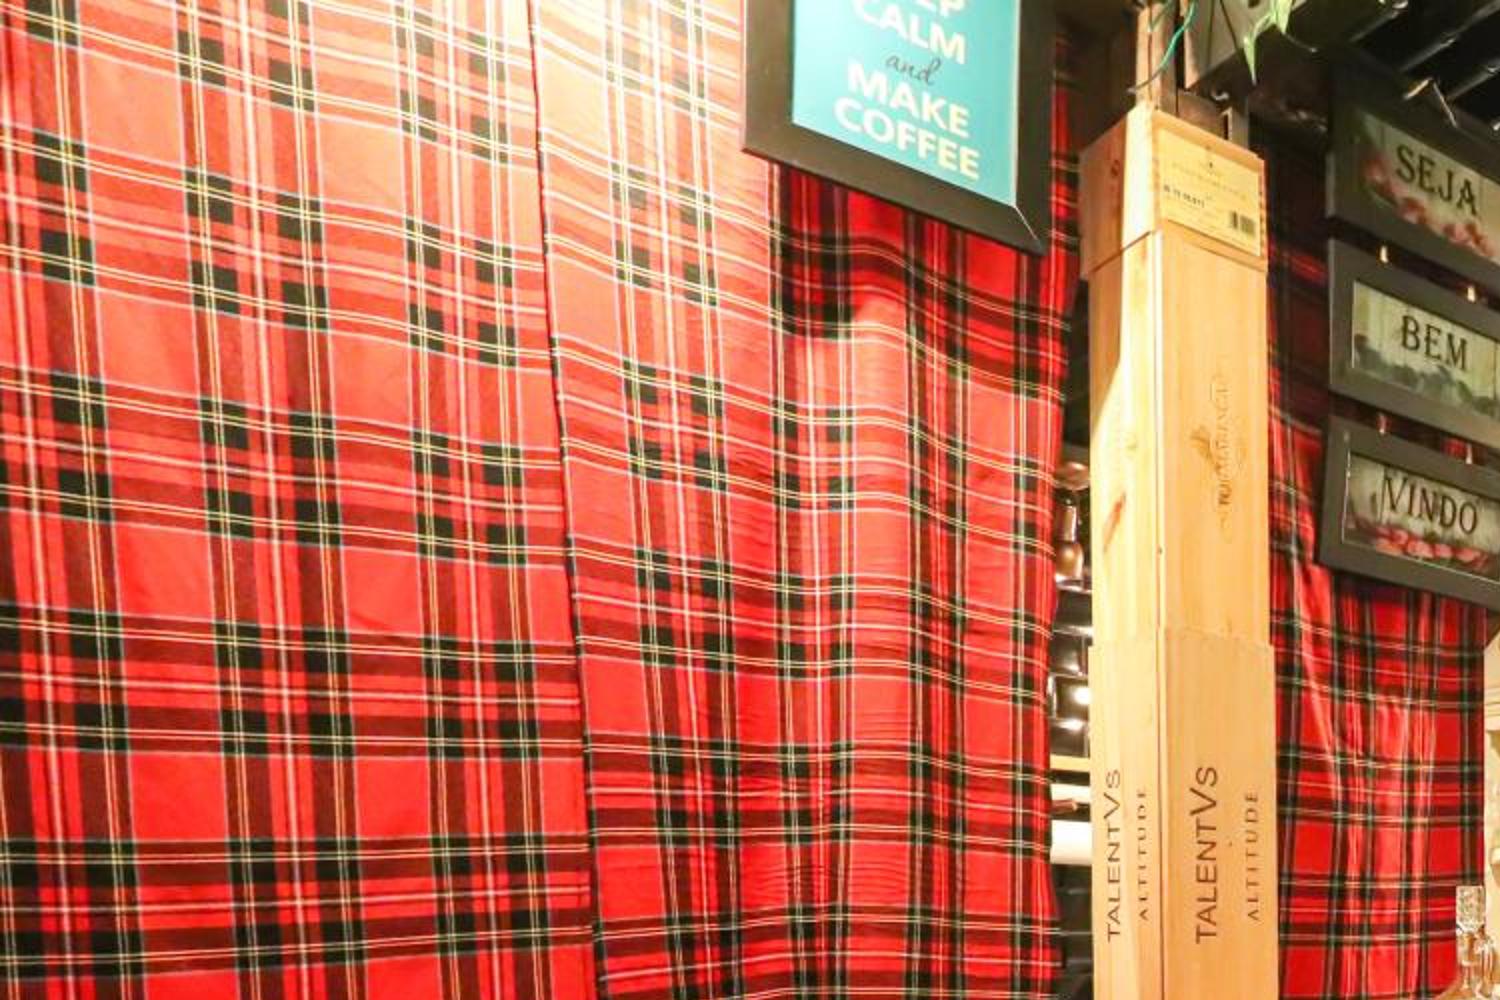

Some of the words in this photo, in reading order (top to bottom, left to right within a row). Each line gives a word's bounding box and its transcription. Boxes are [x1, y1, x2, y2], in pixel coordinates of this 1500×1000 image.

[853, 0, 967, 65] CALM
[847, 60, 970, 139] MAKE
[885, 55, 942, 86] and
[833, 97, 981, 181] COFFEE
[1395, 143, 1478, 217] SEJA
[1400, 313, 1468, 371] BEM
[1381, 472, 1478, 536] VINDO
[1137, 788, 1149, 921] ALTITUDE
[1244, 790, 1259, 921] ALTITUDE
